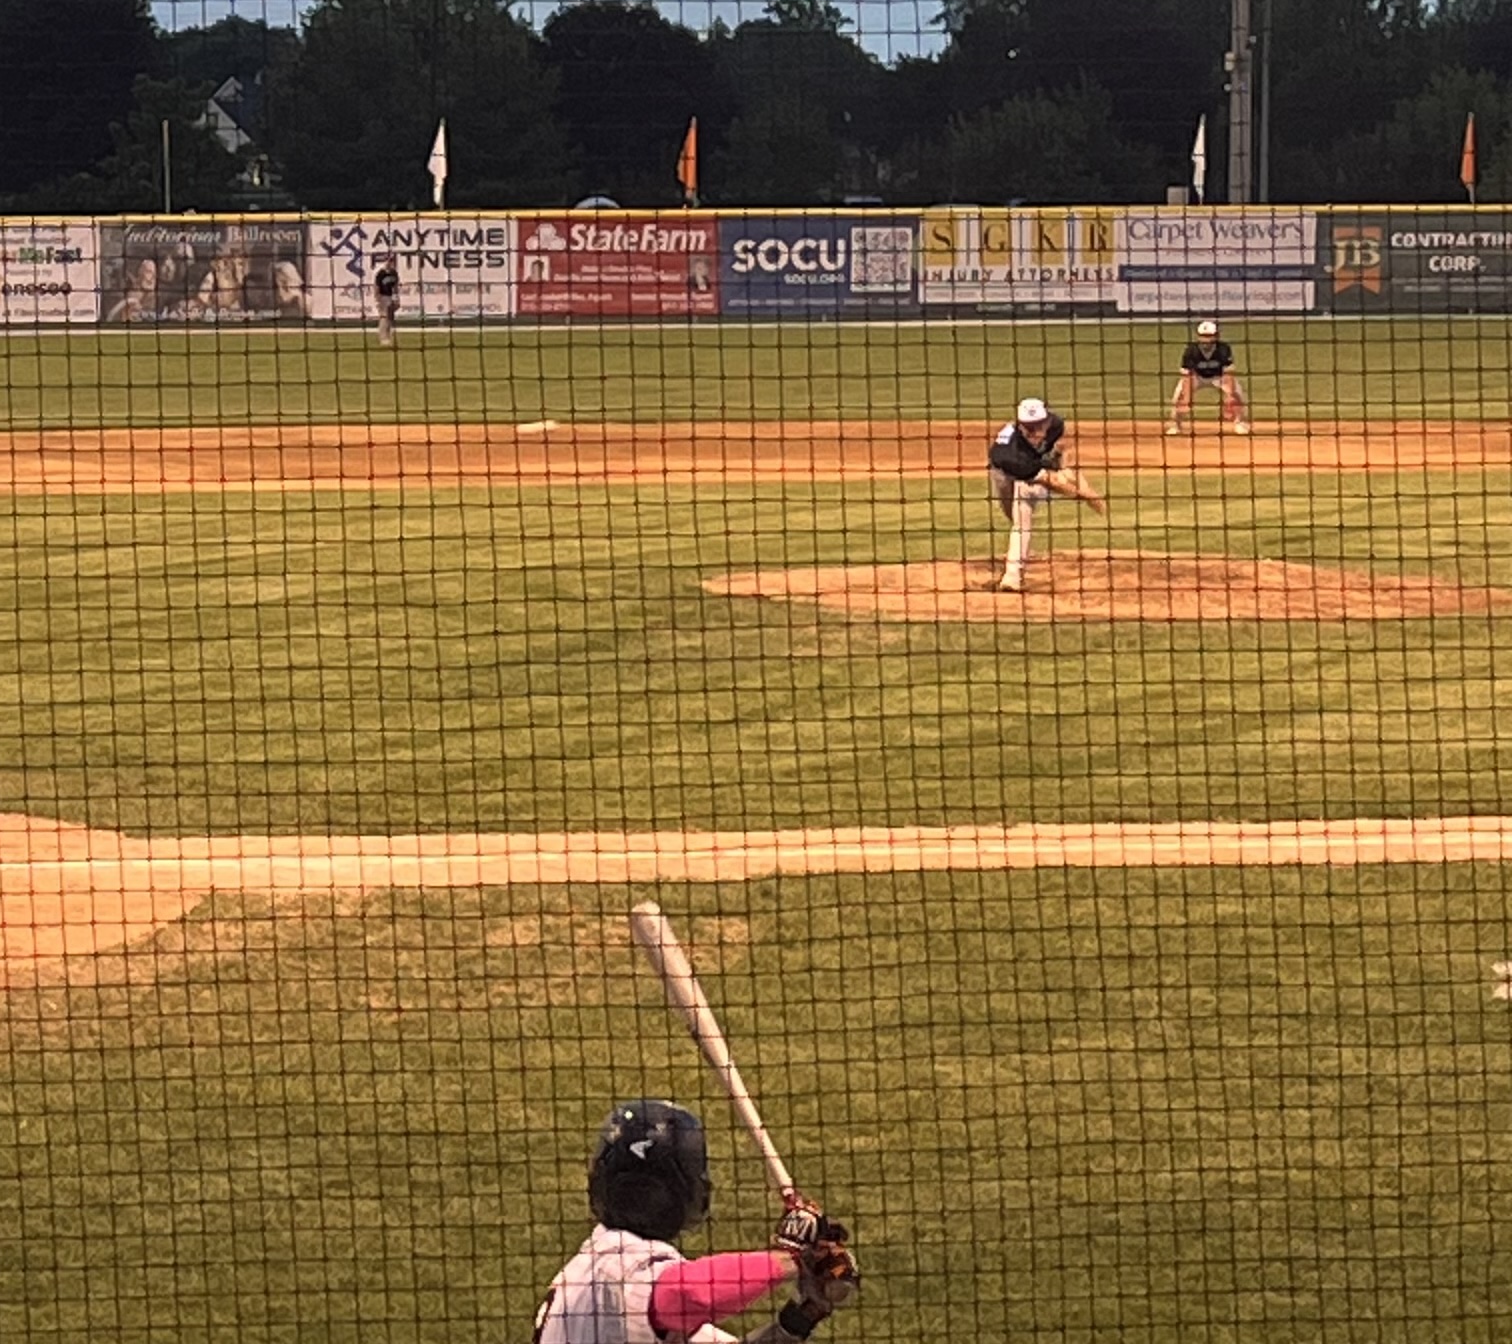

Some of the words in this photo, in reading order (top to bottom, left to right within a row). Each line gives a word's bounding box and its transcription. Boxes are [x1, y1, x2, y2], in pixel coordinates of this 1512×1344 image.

[371, 228, 504, 248] ANYTIME
[1129, 219, 1203, 244] Carpet
[1209, 219, 1304, 241] Weavers
[371, 251, 505, 269] FTNESS
[731, 237, 847, 273] SOCU
[1429, 255, 1486, 271] CORP.
